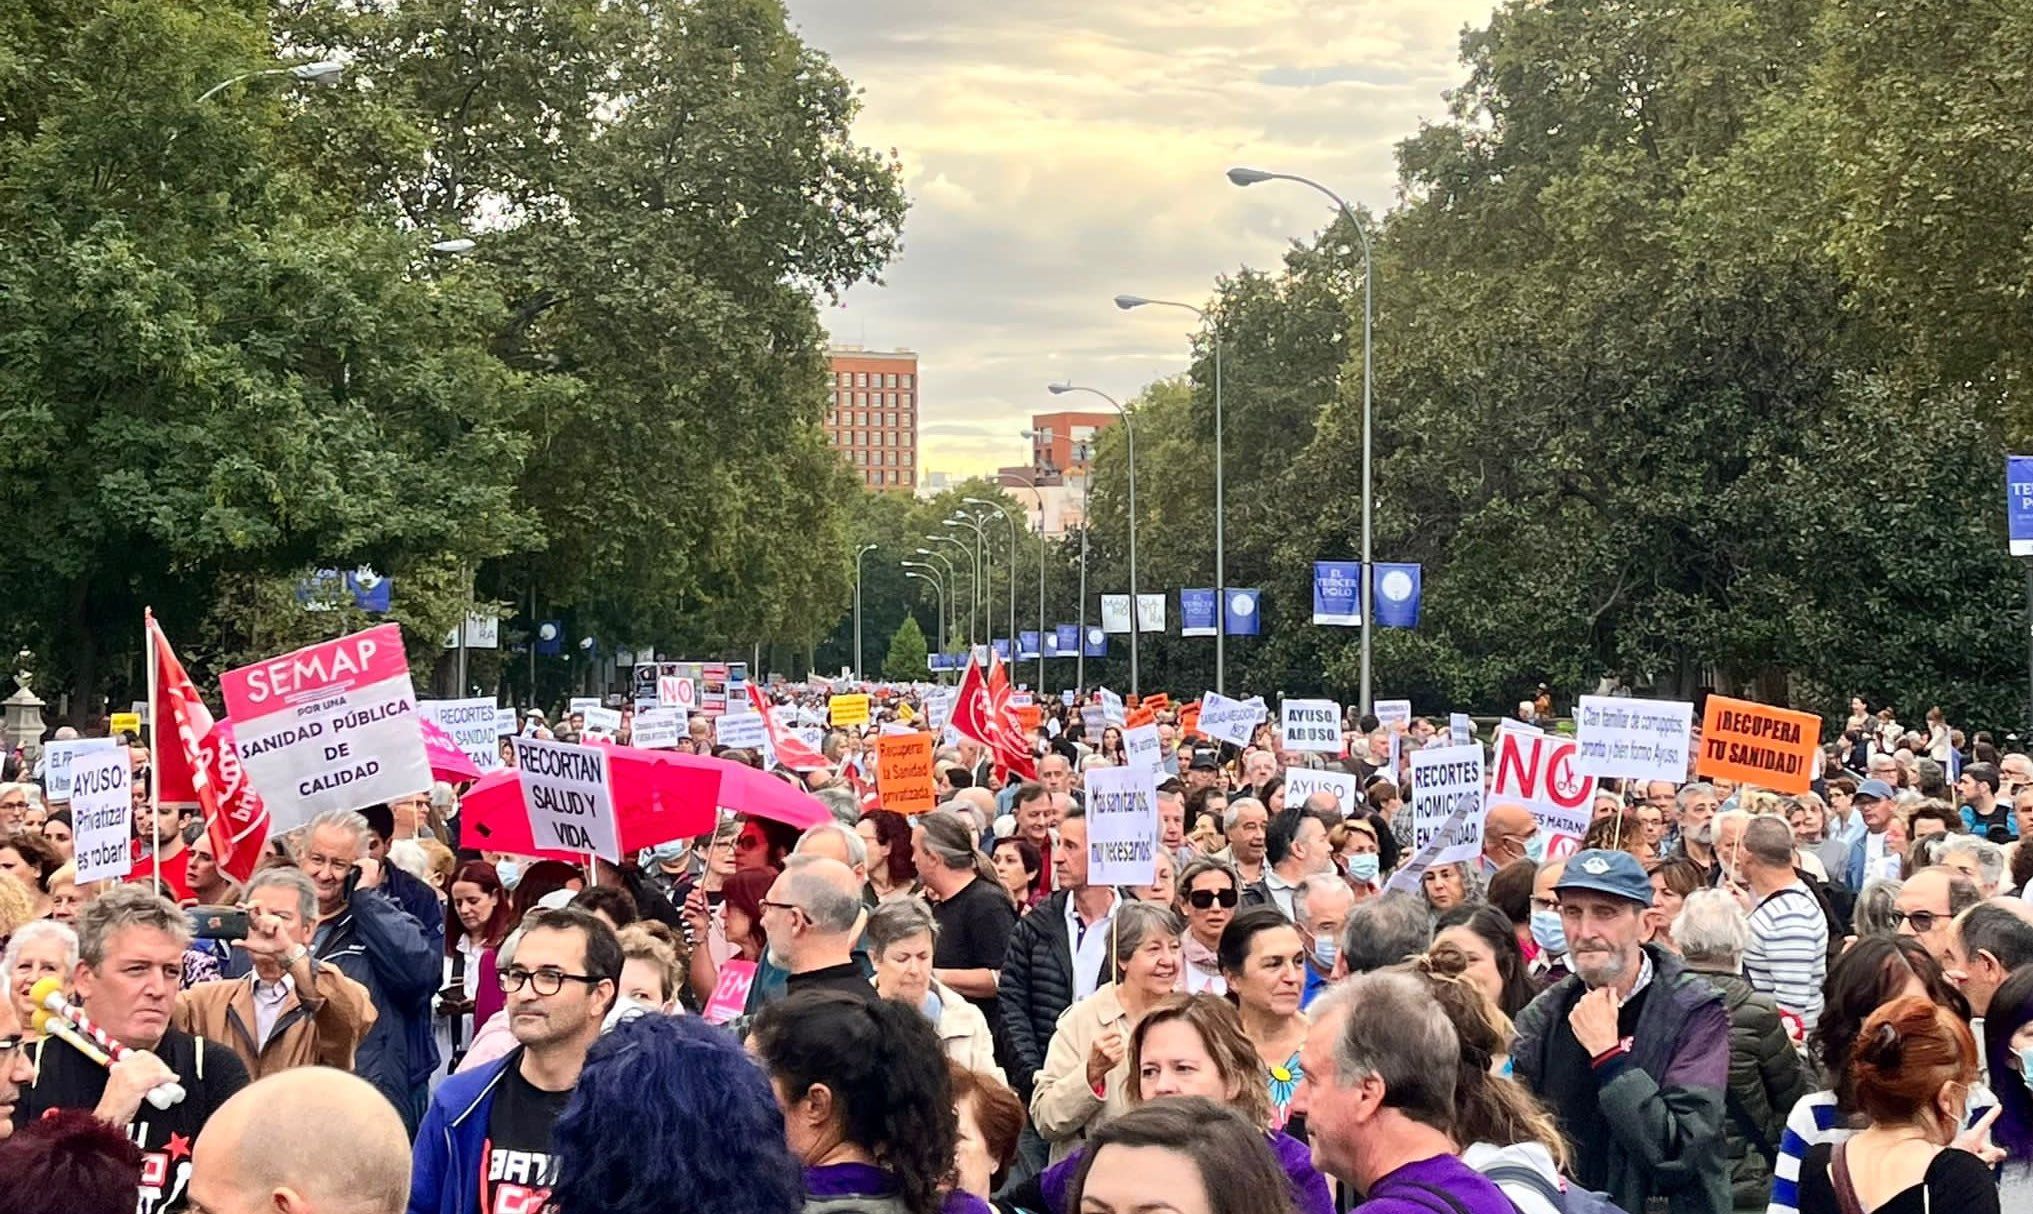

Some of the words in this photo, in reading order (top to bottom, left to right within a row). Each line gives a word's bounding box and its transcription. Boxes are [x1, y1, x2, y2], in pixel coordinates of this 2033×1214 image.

[1321, 586, 1352, 597] POLO
[246, 638, 377, 703] SEMAP
[297, 704, 321, 717] POR
[322, 696, 348, 711] UNA
[661, 678, 693, 704] NO
[240, 722, 323, 760] SANIDAD
[332, 699, 411, 734] PÚBLICA
[440, 705, 495, 724] RECORTES
[1716, 710, 1801, 744] ¡RECUPERA
[324, 742, 351, 762] DE
[518, 743, 602, 784] RECORTAN
[1707, 738, 1727, 761] TU
[1728, 743, 1804, 776] SANIDAD!
[72, 765, 127, 798] AYUSO:
[299, 760, 380, 796] CALIDAD
[892, 762, 928, 780] Sanidad
[1415, 760, 1479, 789] RECORTES
[1494, 734, 1593, 808] NO
[532, 784, 585, 816] SALUD
[584, 792, 596, 818] Y
[552, 820, 596, 850] VIDA
[1417, 827, 1430, 850] EN
[77, 851, 89, 872] es
[91, 837, 127, 868] robar!
